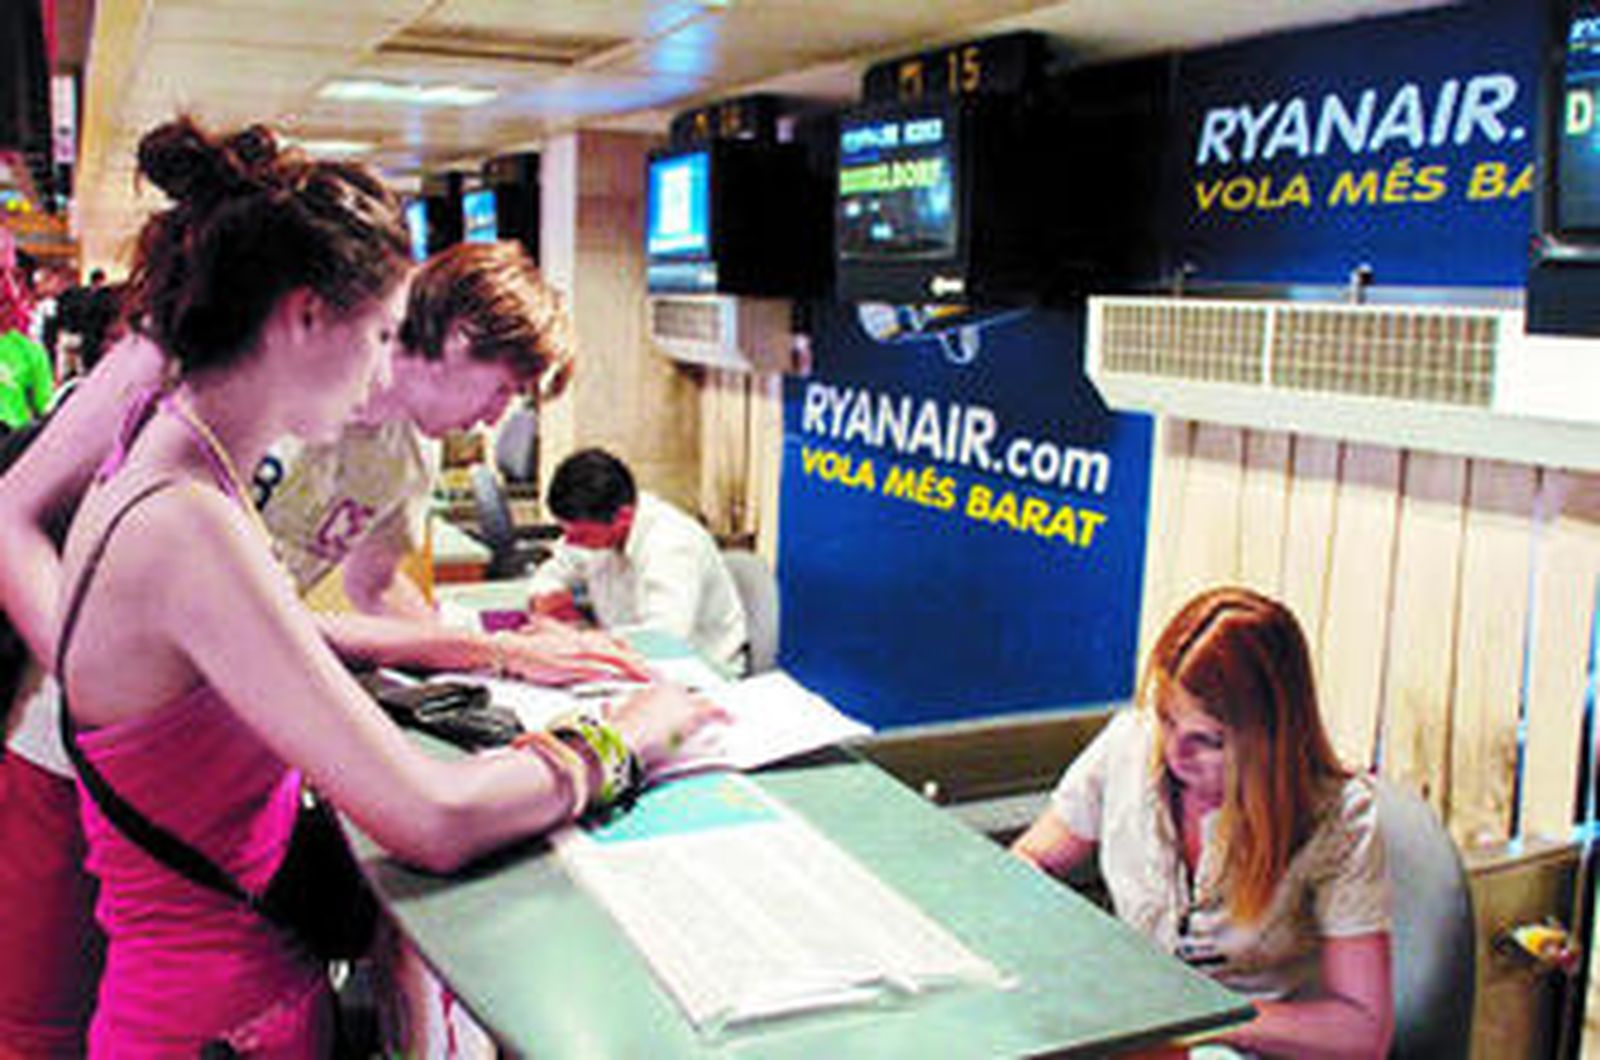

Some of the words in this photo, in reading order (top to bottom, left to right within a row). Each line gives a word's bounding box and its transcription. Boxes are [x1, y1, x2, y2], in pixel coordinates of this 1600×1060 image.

[947, 46, 982, 96] 15
[1196, 74, 1526, 165] RYANAIR.
[1195, 172, 1311, 211] VOLA
[1327, 157, 1448, 208] MÉS
[803, 382, 1110, 494] RYANAIR.com
[801, 445, 876, 492] VOLA
[882, 464, 957, 510] MÉS
[965, 483, 1108, 548] BARAT
